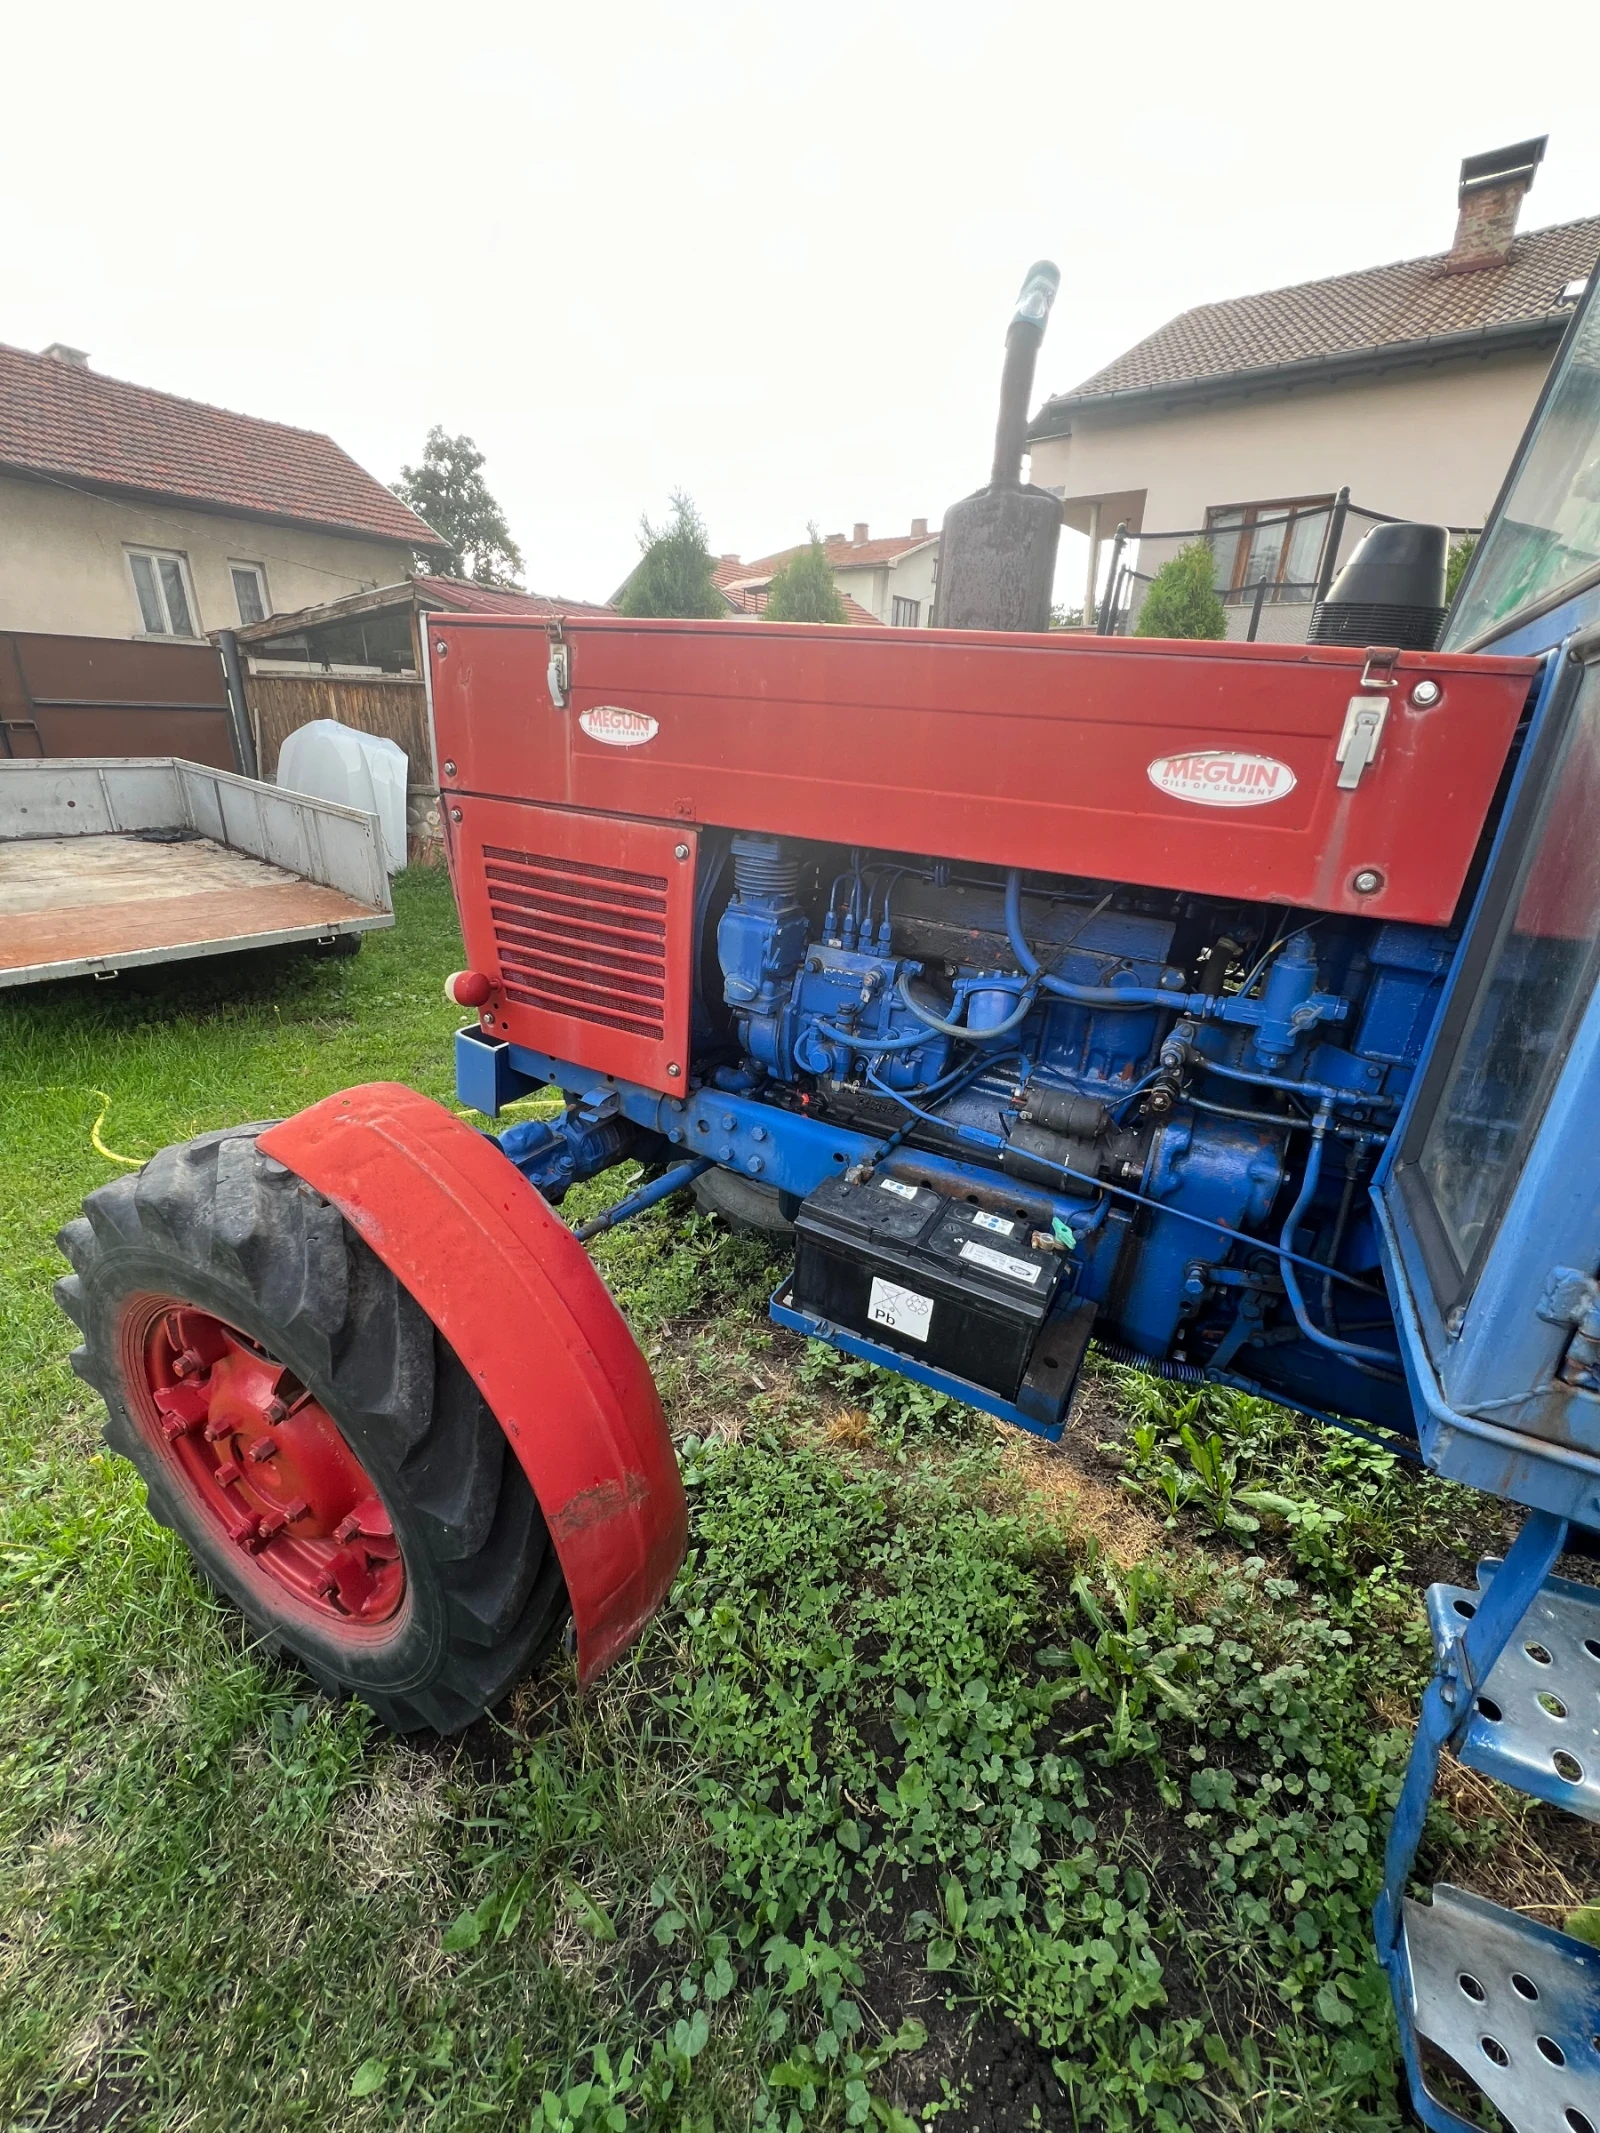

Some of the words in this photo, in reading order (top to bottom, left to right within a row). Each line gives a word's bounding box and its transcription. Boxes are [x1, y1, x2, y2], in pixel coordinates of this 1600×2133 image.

[1161, 778, 1187, 788] OILS
[1192, 782, 1208, 790] OF
[1213, 785, 1275, 796] GERMANY
[875, 1308, 896, 1326] Pb
